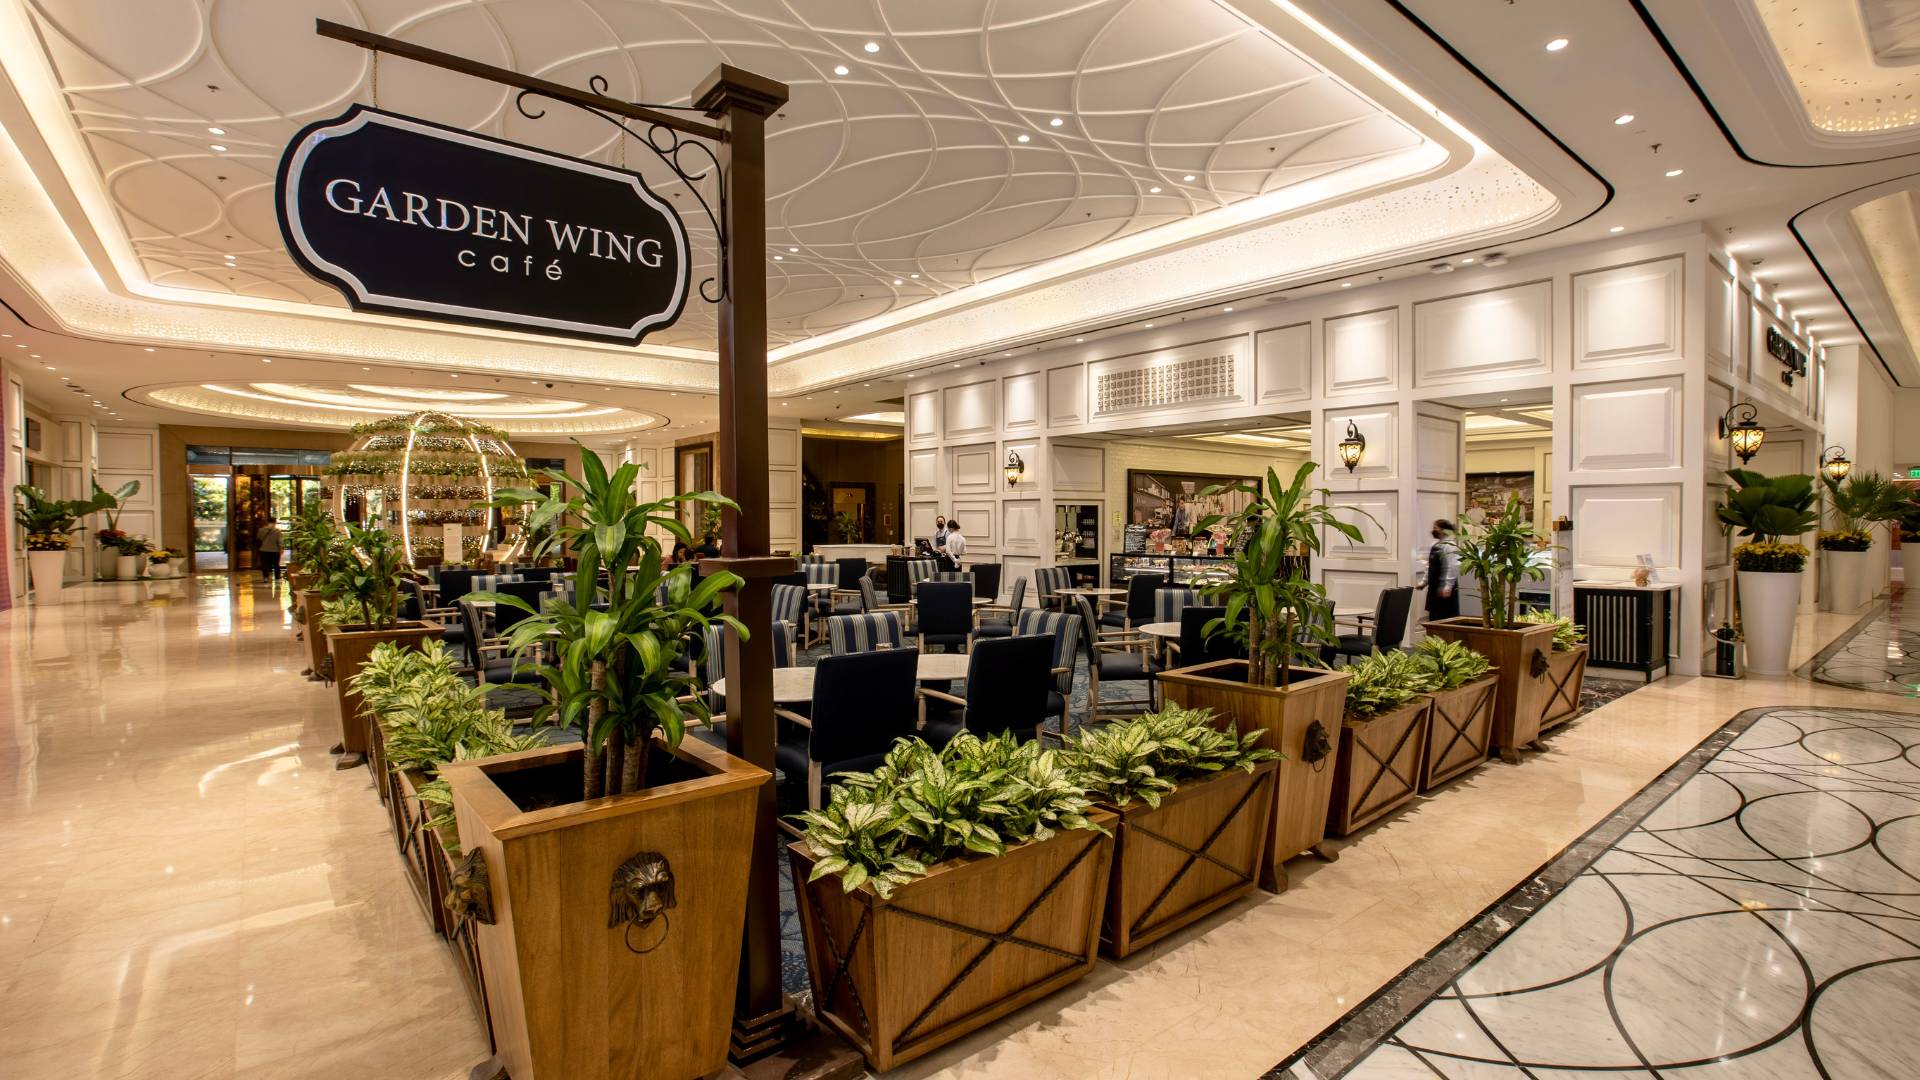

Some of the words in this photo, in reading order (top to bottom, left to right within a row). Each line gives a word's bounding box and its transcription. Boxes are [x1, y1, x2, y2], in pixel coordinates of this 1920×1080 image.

[325, 178, 533, 245] GARDEN
[546, 219, 664, 268] WING
[458, 249, 563, 281] café
